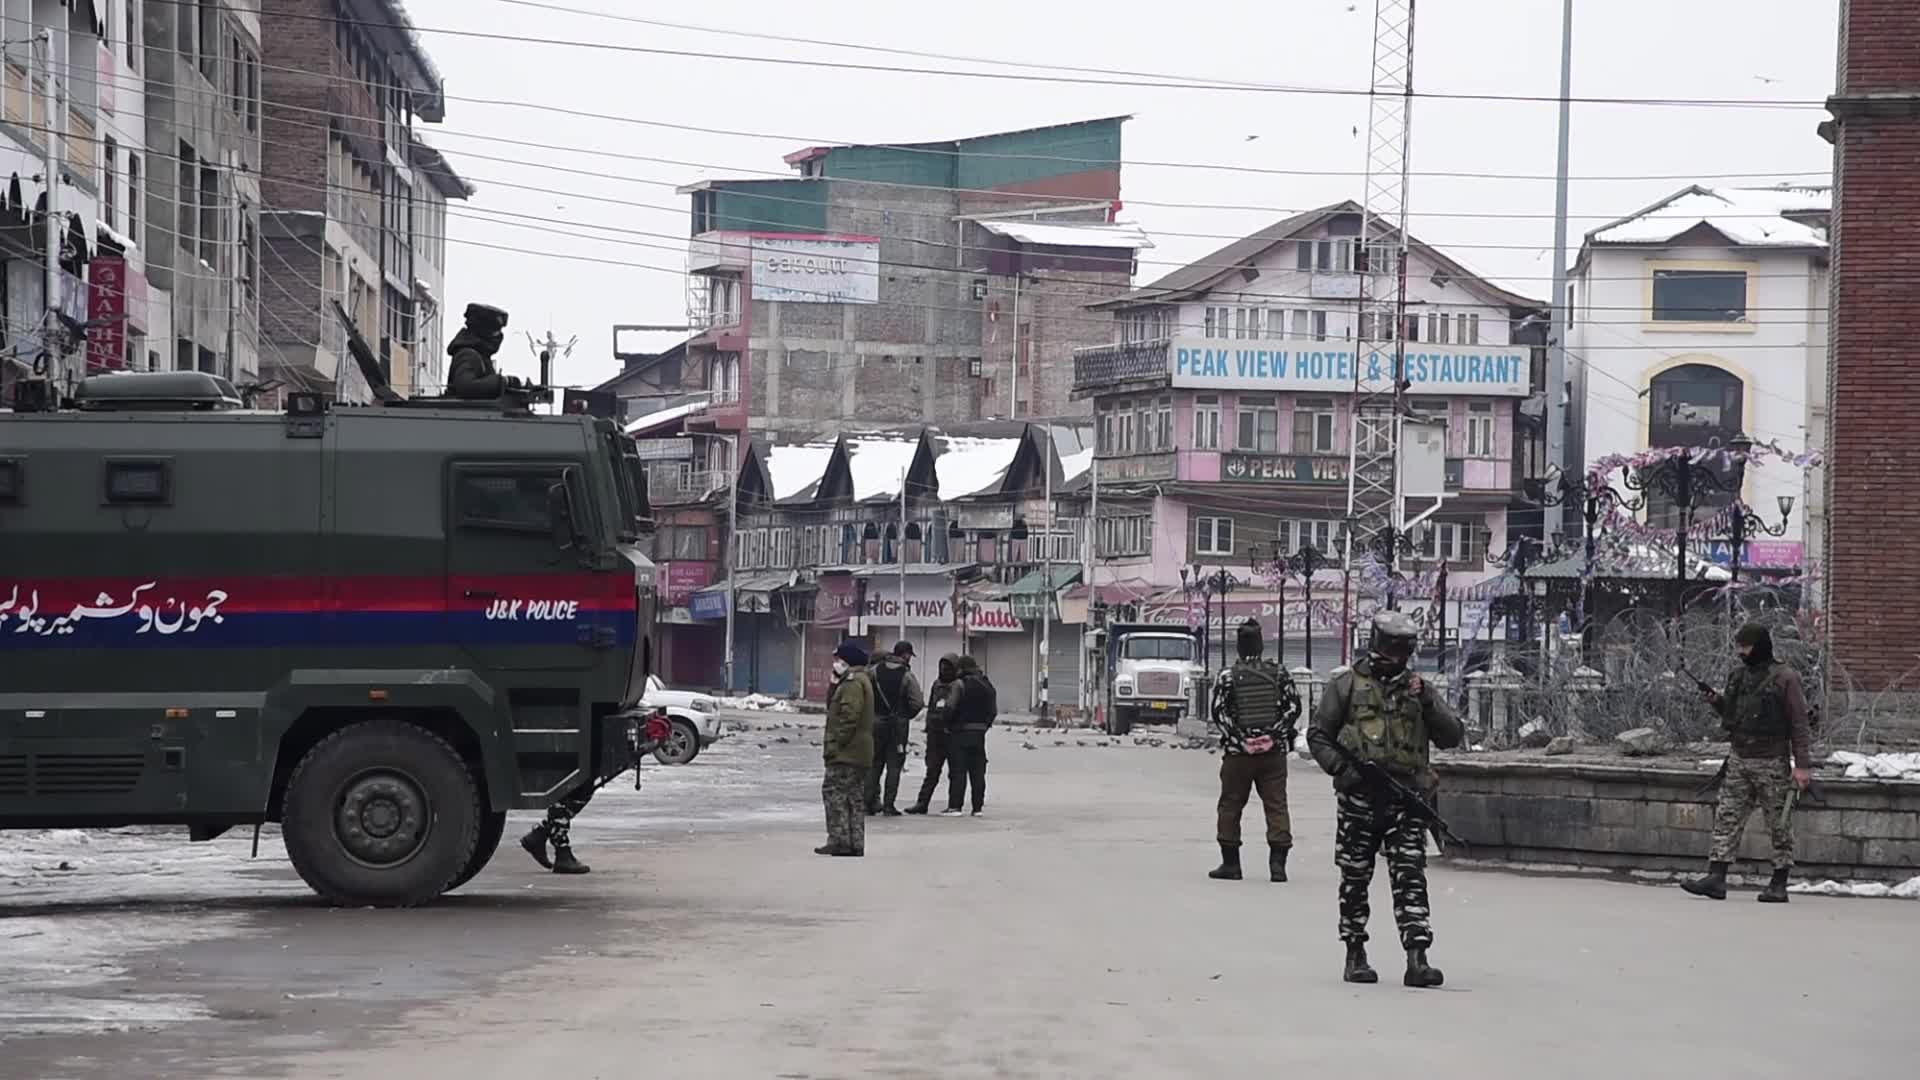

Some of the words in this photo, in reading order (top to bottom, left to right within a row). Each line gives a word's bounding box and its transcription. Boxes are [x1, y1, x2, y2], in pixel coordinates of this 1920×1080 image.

[1177, 348, 1229, 377] PEAK
[1236, 350, 1289, 379] VIEW
[1296, 351, 1356, 380] HOTEL
[1367, 352, 1381, 381] &
[1250, 459, 1297, 479] PEAK
[485, 599, 522, 620] J&K
[526, 599, 579, 620] POLICE
[970, 605, 1020, 628] Bata
